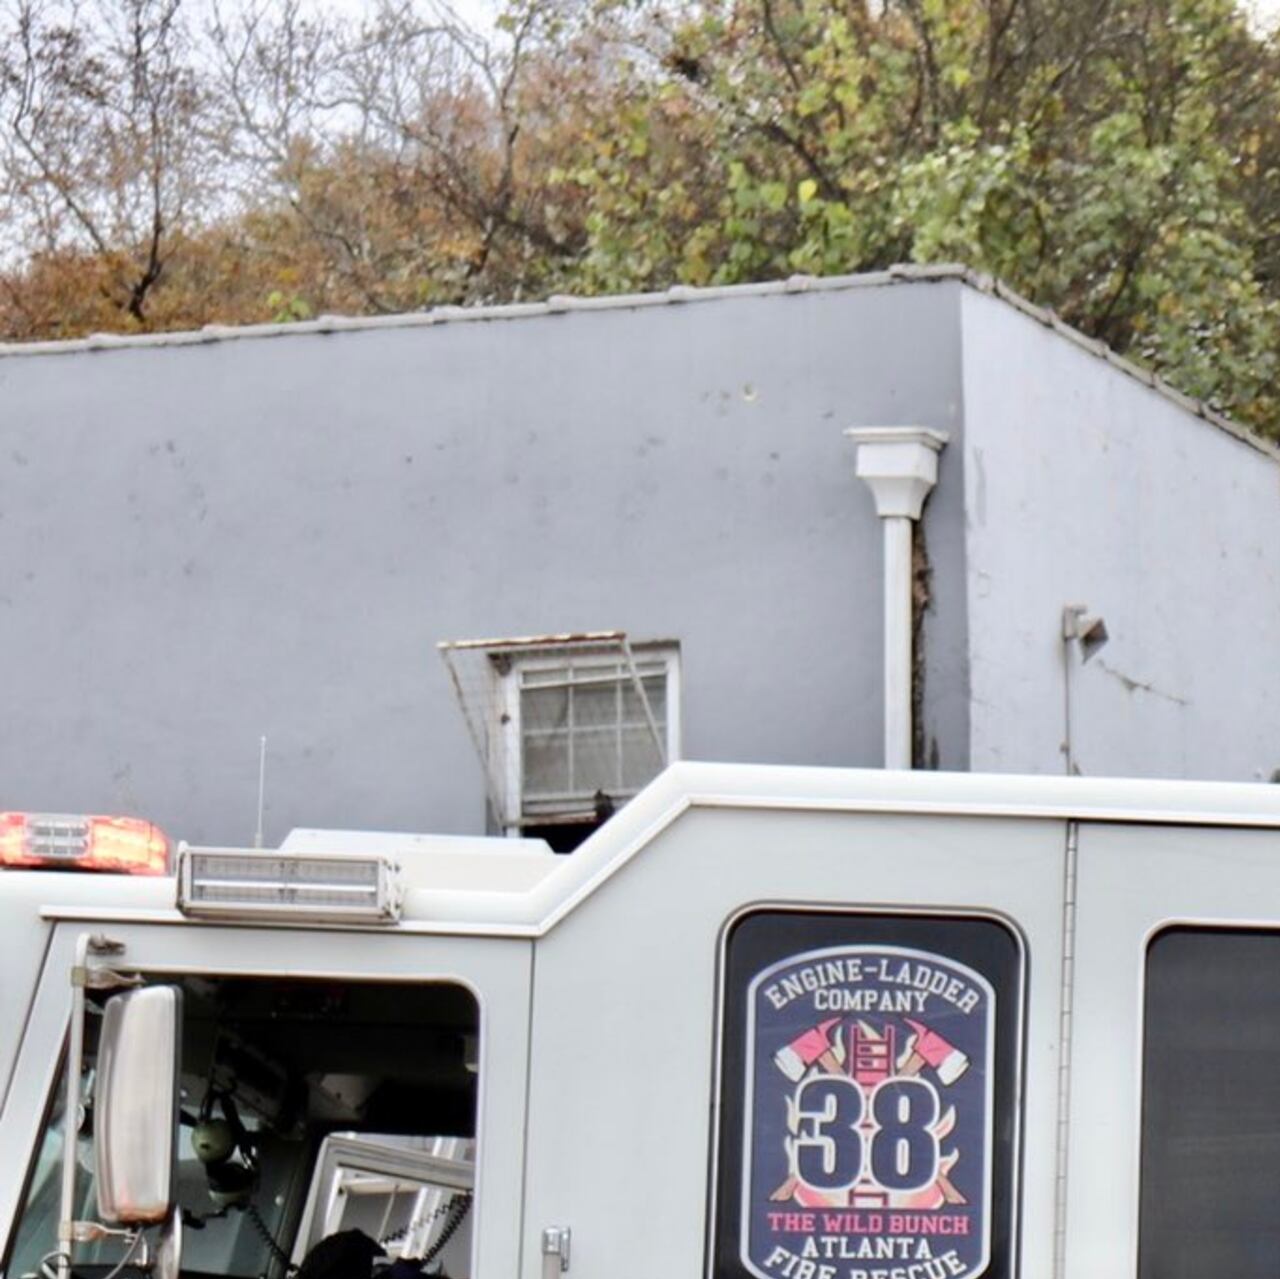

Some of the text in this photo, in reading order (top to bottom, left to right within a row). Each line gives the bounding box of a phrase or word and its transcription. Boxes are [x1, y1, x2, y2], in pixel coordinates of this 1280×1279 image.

[764, 958, 980, 1014] ENGINE-LADDER
[813, 988, 929, 1012] COMPANY
[795, 1074, 941, 1193] 38
[767, 1212, 970, 1235] THE WILD BUNCH
[801, 1236, 934, 1260] ATLANTA
